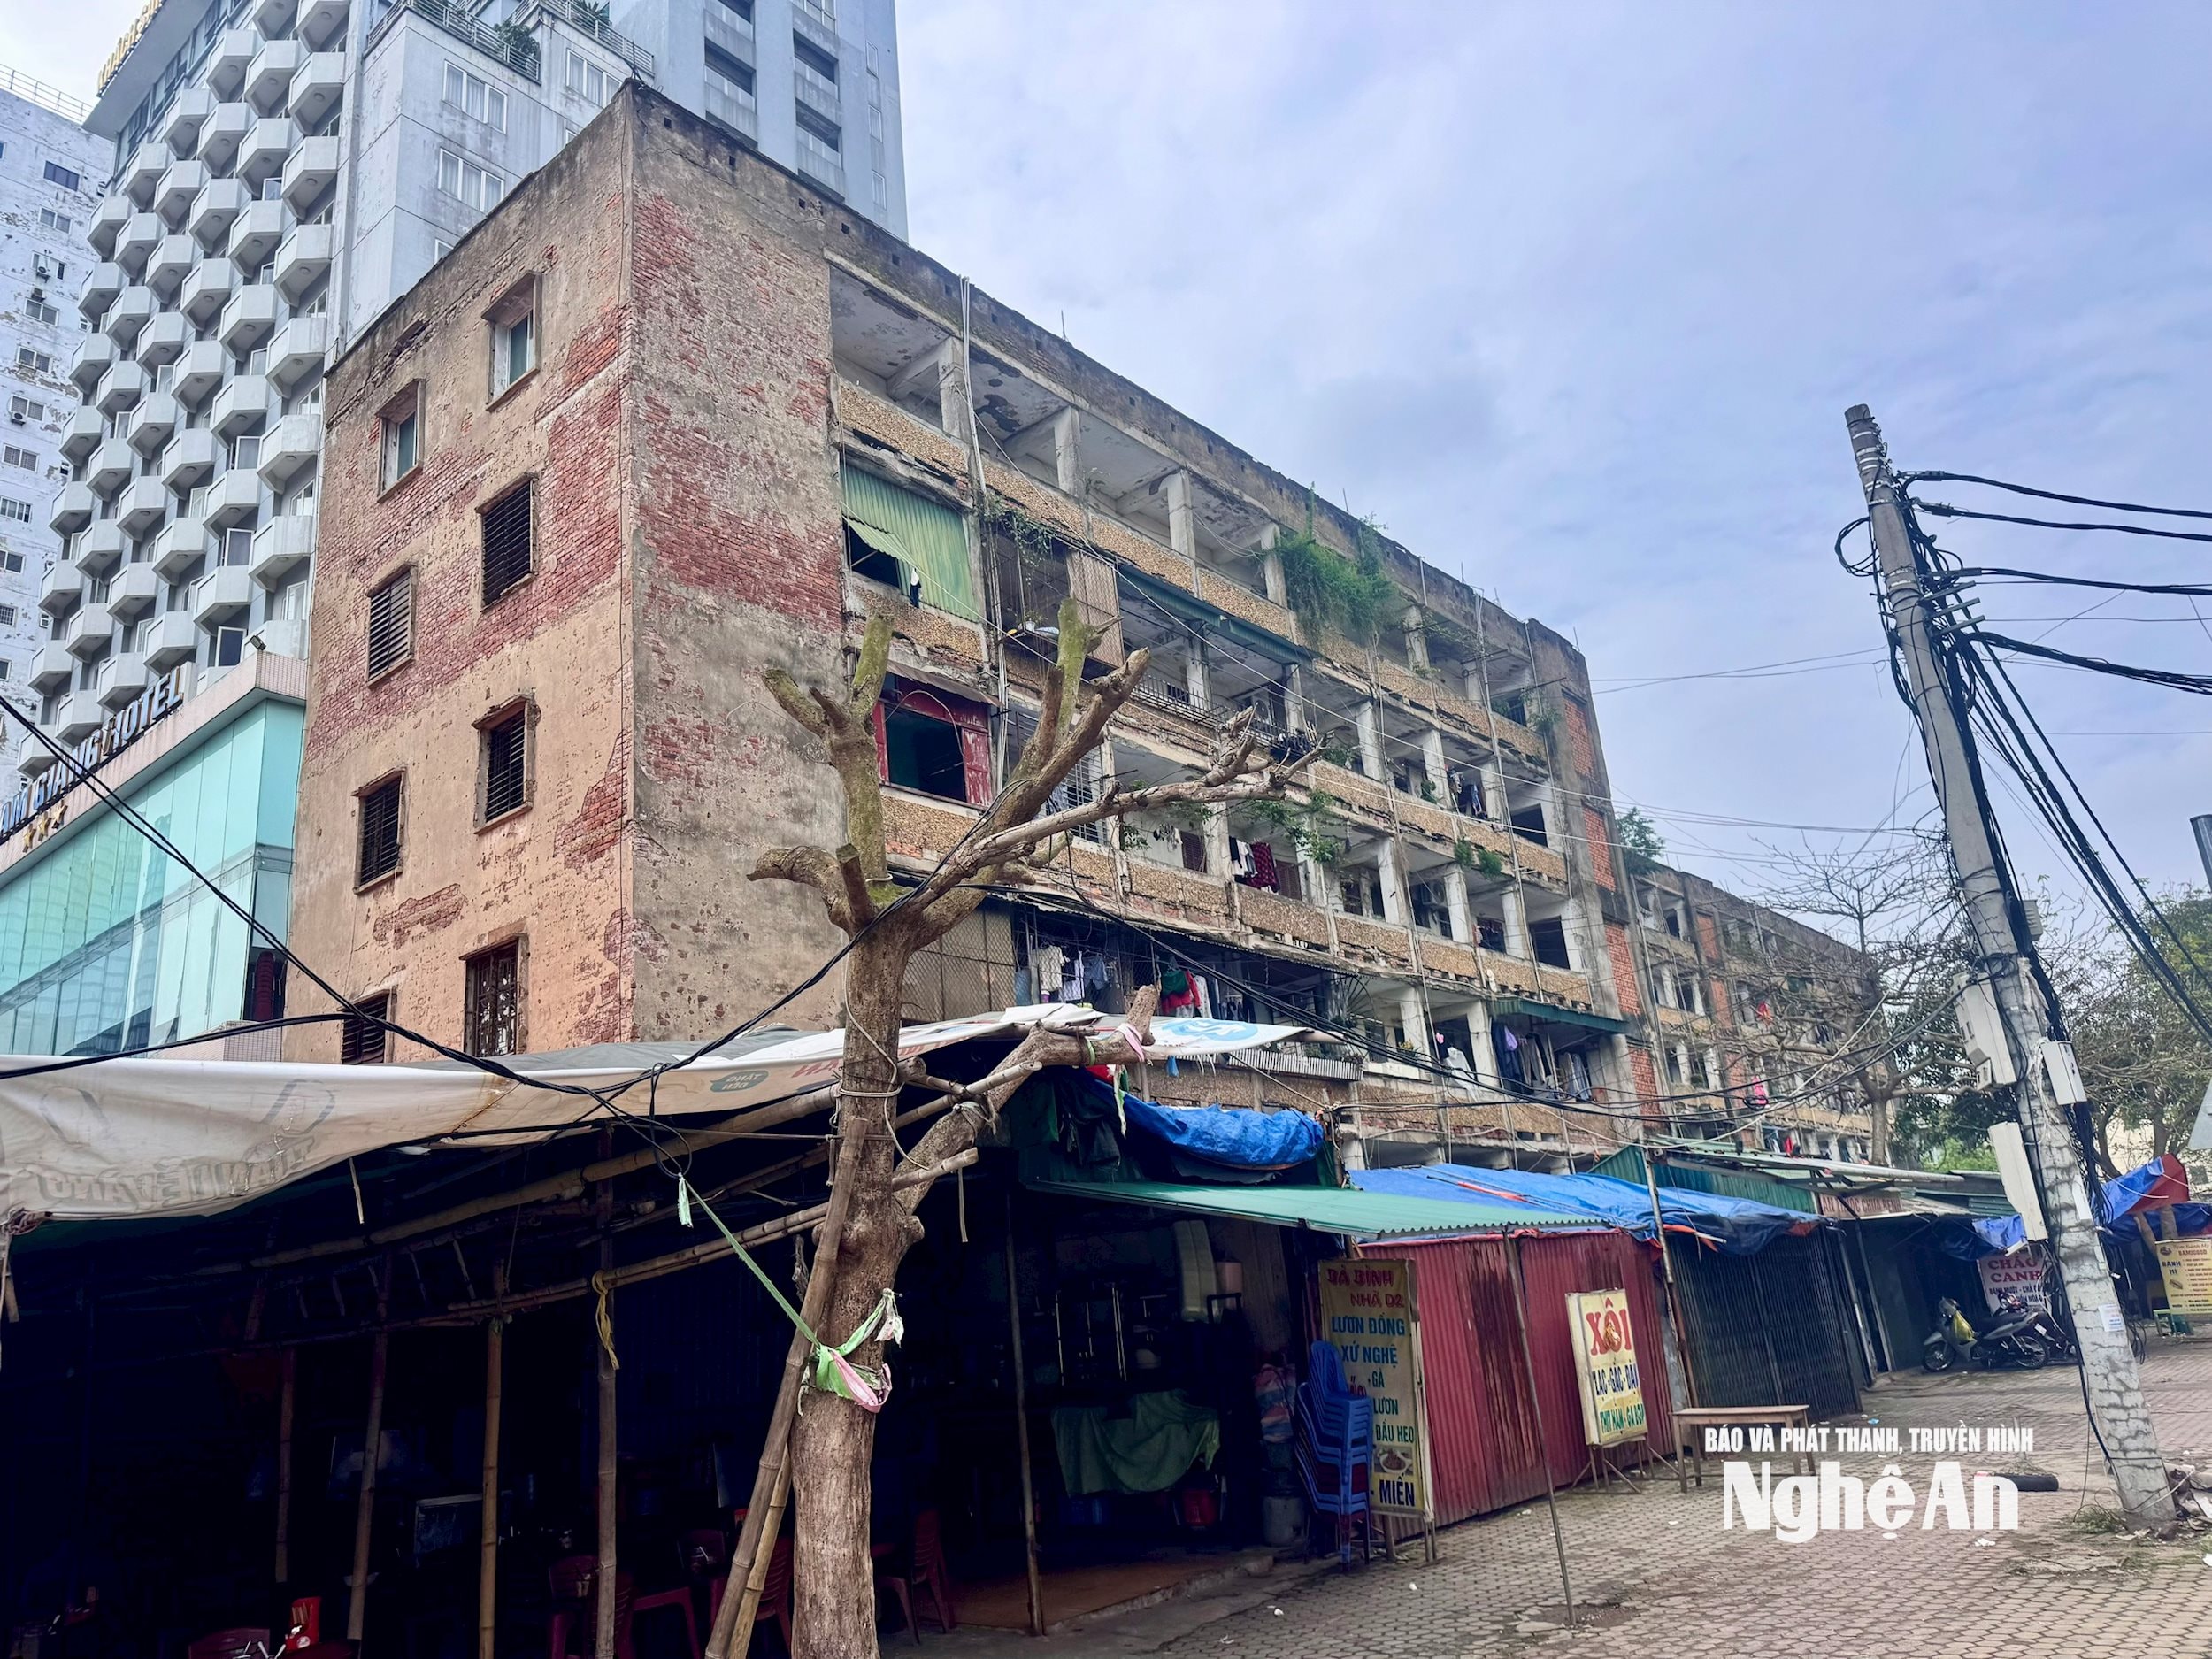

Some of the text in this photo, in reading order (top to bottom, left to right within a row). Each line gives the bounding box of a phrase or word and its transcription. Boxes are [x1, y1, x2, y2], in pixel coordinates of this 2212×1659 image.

[102, 665, 184, 757] HOTEL
[1327, 1263, 1394, 1287] BÀ BÌNH
[1350, 1290, 1382, 1308] NHÀ
[1586, 1297, 1632, 1356] XÔI
[1341, 1340, 1399, 1369] XỨ NGHỆ
[1397, 1425, 1415, 1444] HEO
[1379, 1472, 1416, 1507] MIẾN
